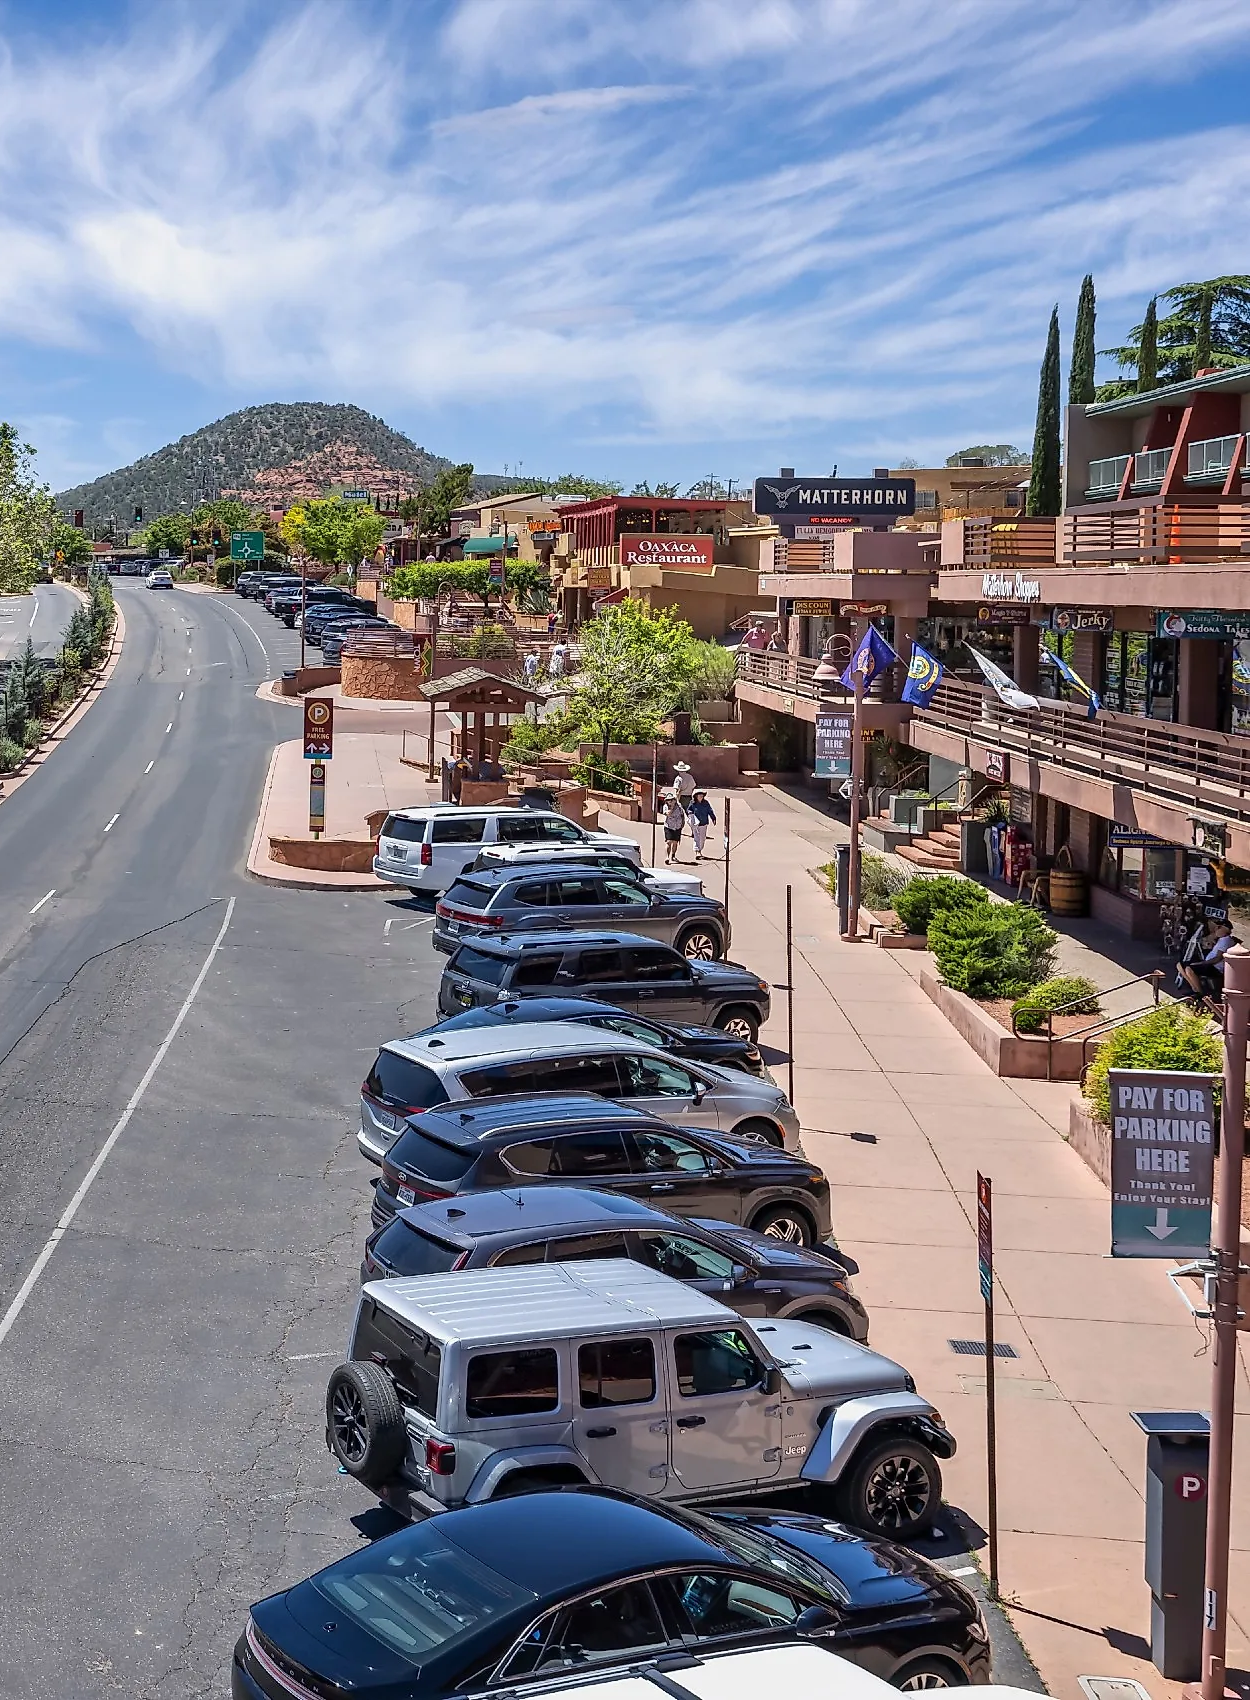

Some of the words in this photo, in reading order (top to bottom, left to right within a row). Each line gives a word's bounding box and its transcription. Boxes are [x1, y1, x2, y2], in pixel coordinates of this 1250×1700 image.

[799, 489, 907, 505] MATTERHORN
[639, 541, 697, 554] OAXACA
[626, 552, 707, 565] Restaurant
[1072, 613, 1110, 630] Jerky
[314, 707, 325, 720] P
[818, 719, 832, 727] PAY
[834, 719, 849, 728] FOR
[824, 740, 844, 749] HERE
[1205, 907, 1226, 919] OPEN
[1118, 1086, 1157, 1110] PAY
[1162, 1088, 1205, 1112] FOR
[1114, 1116, 1211, 1143] PARKING
[1135, 1148, 1190, 1173] HERE
[1130, 1180, 1166, 1191] Thank
[1169, 1182, 1196, 1192] You!
[1113, 1193, 1147, 1203] Enjoy
[1150, 1194, 1177, 1204] Your
[1180, 1196, 1210, 1206] Stay!
[785, 1446, 807, 1455] Jeep
[1182, 1476, 1201, 1498] P
[1205, 1590, 1215, 1628] 117
